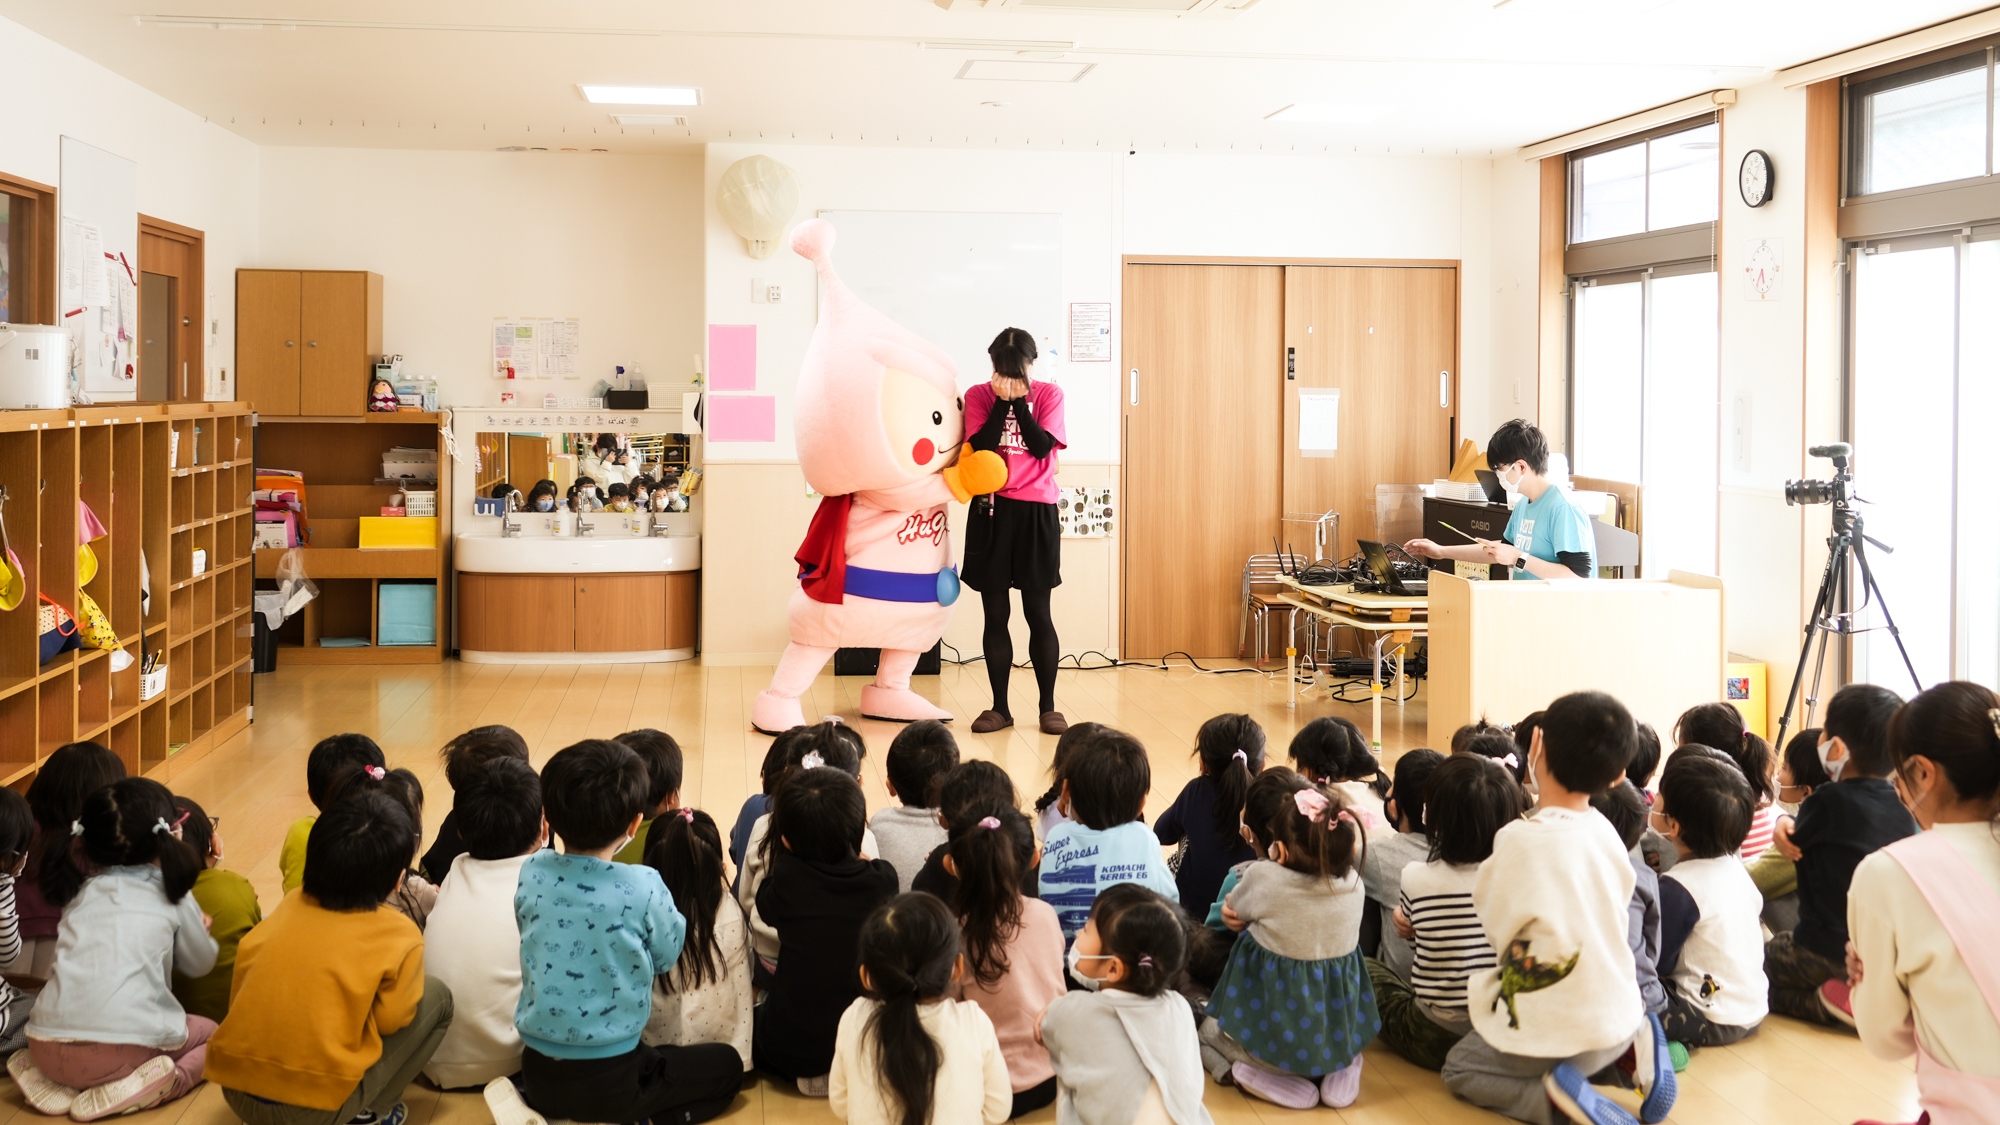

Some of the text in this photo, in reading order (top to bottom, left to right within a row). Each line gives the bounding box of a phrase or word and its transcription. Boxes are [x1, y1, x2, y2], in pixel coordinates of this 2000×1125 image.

[897, 510, 950, 546] Hug
[1471, 520, 1490, 531] CASIO
[1042, 836, 1070, 857] Super
[1056, 845, 1099, 870] Express
[1100, 872, 1148, 881] SERIES E6
[1102, 864, 1146, 873] KOMACHI
